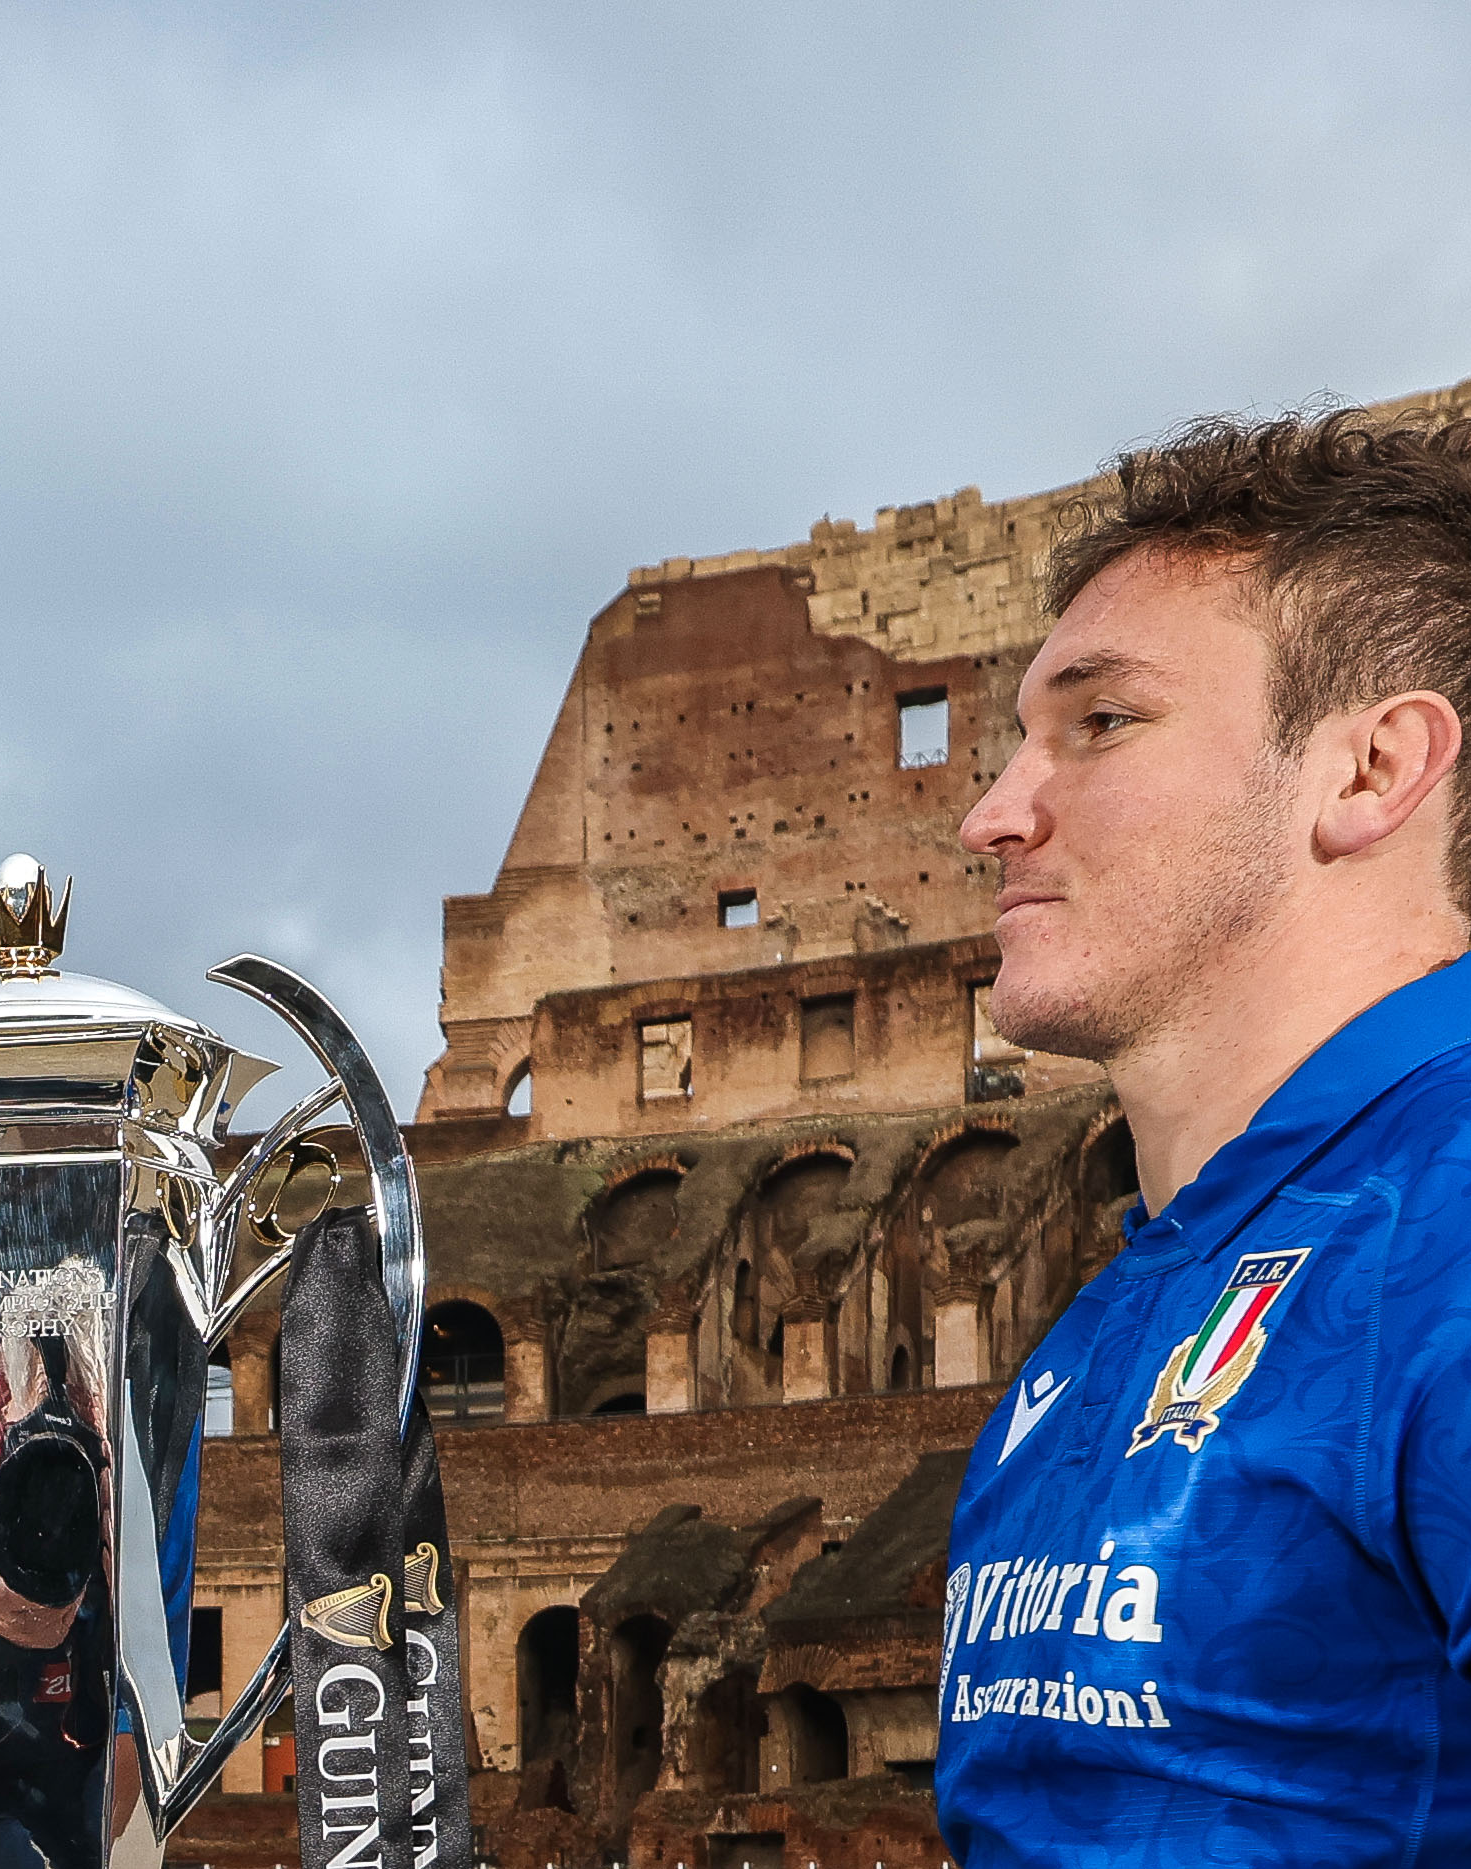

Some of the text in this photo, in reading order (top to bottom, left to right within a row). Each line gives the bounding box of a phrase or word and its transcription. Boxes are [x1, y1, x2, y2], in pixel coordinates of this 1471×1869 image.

[1237, 1261, 1288, 1284] F.I.R.
[1159, 1403, 1200, 1424] ITALIA
[966, 1540, 1163, 1644] Vittoria
